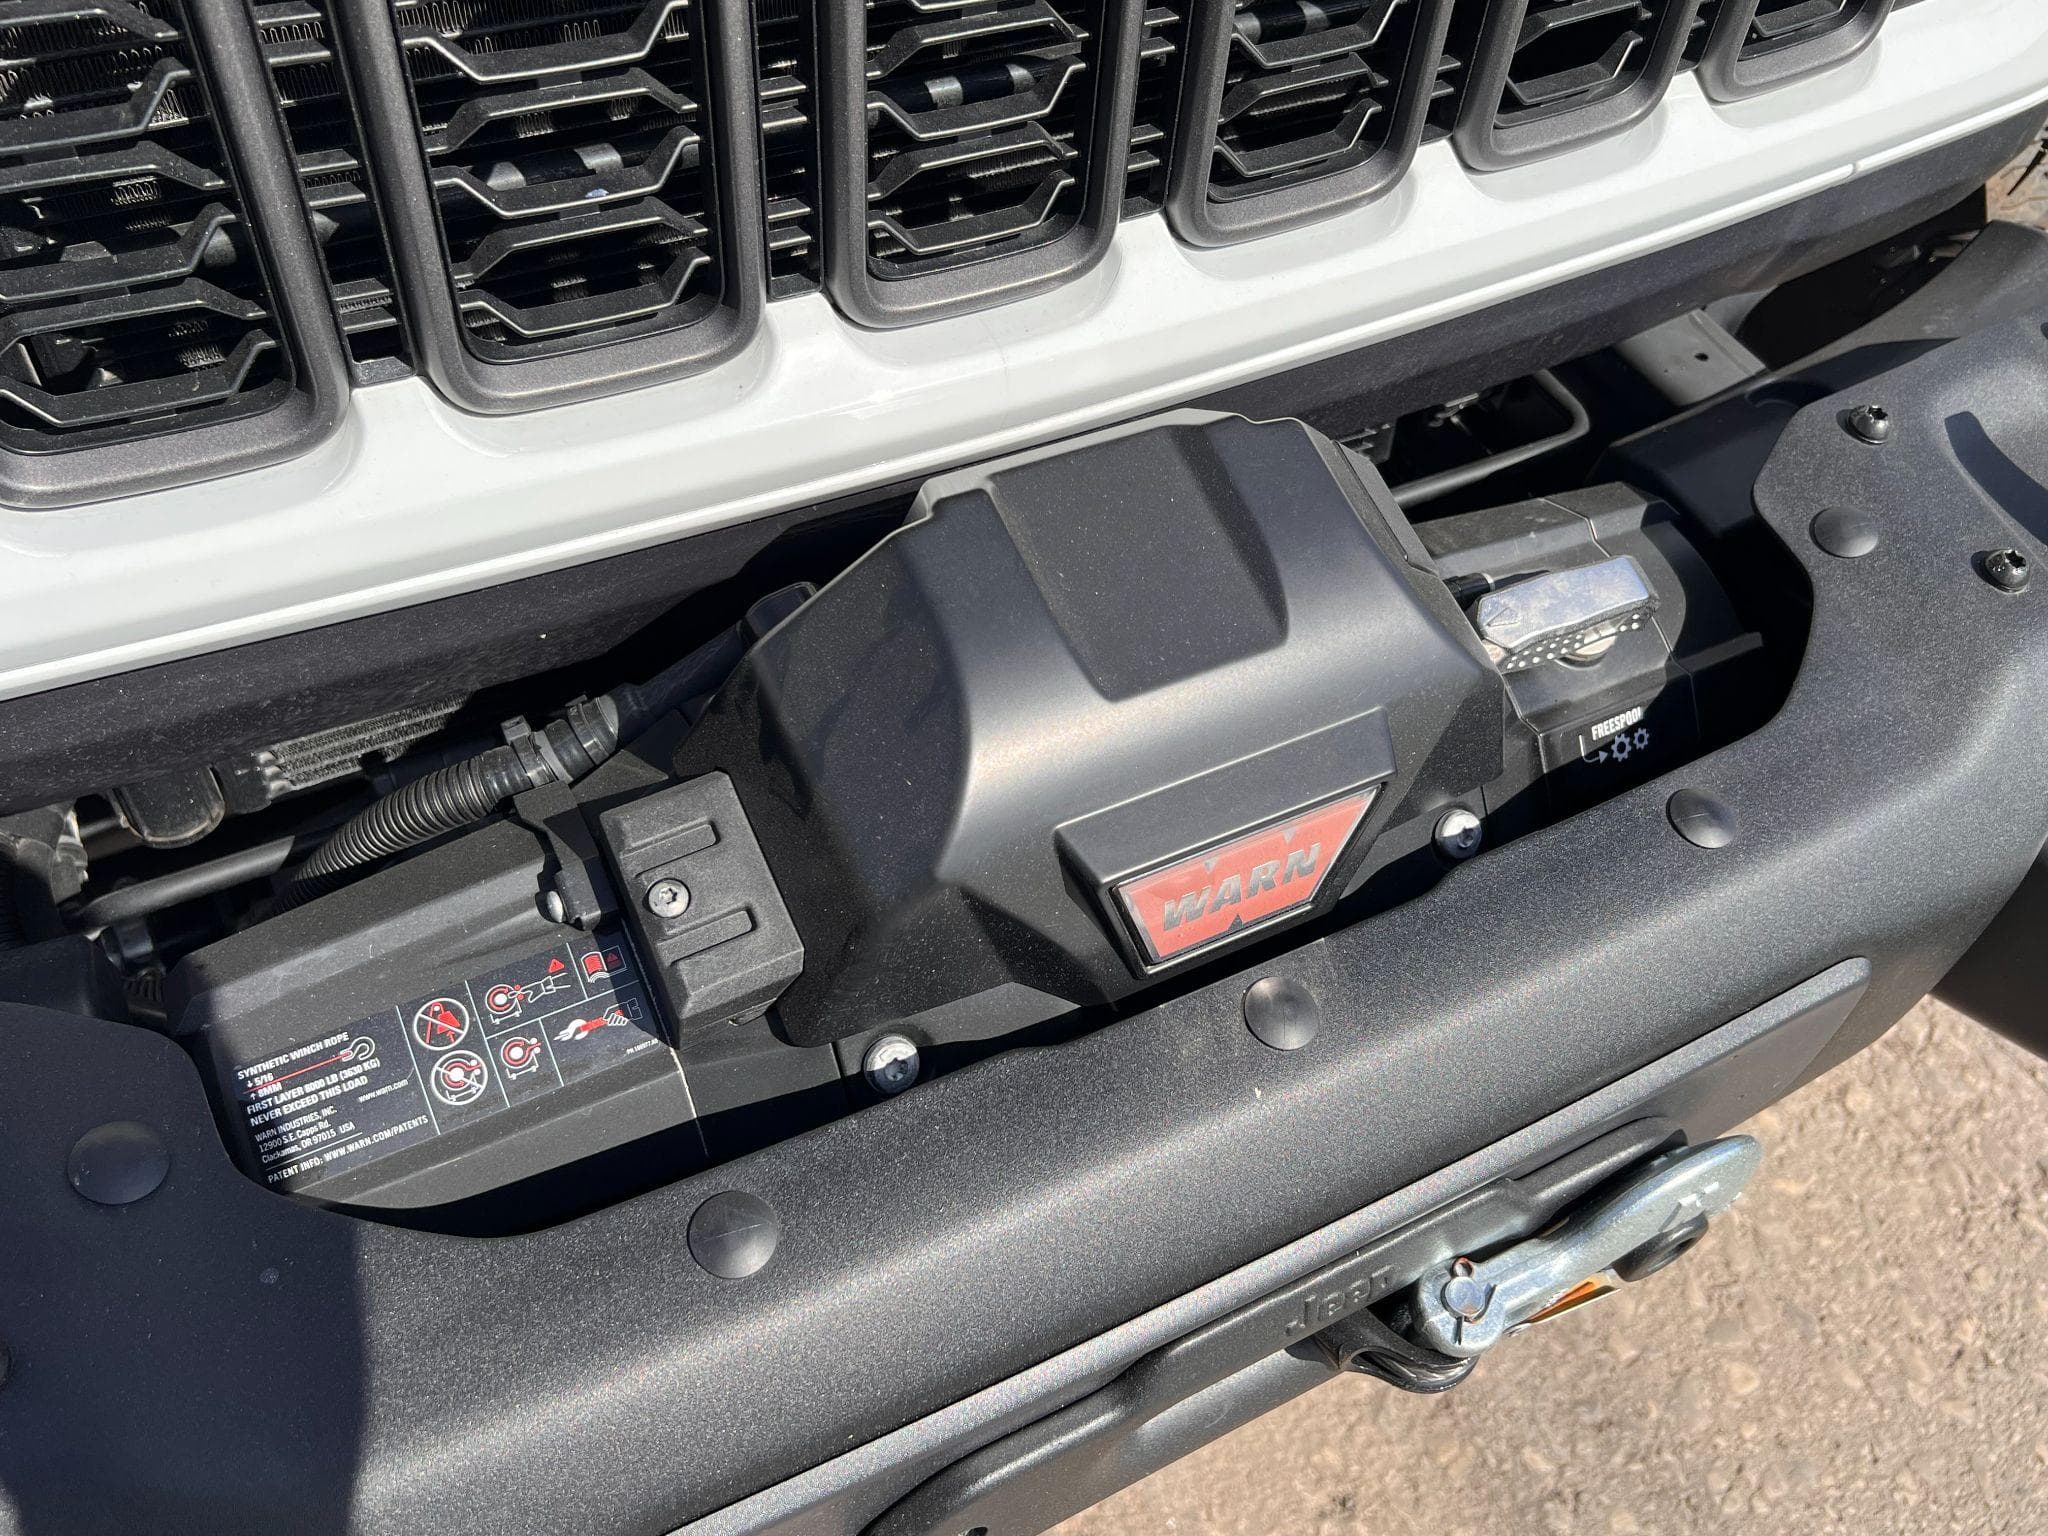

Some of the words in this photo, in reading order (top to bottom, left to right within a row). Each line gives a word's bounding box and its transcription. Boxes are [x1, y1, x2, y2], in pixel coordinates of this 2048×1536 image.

[1163, 842, 1321, 931] WARN
[237, 1053, 290, 1080] SYNTHETIC
[289, 1042, 324, 1062] WINCH
[324, 1031, 350, 1048] ROPE
[246, 1097, 273, 1115] FIRST
[274, 1086, 305, 1105] LAYER
[304, 1078, 326, 1094] 8000
[326, 1073, 339, 1085] LB
[362, 1057, 381, 1071] KG)
[254, 1072, 274, 1086] 5/16
[257, 1081, 283, 1098] 8MM
[358, 1078, 409, 1104] www.warn.com
[249, 1107, 282, 1127] NEVER
[281, 1093, 319, 1115] EXCEED
[318, 1085, 342, 1101] THIS
[342, 1075, 369, 1092] LOAD
[254, 1125, 278, 1143] WARN
[276, 1111, 322, 1134] INDUSTRIES,
[321, 1105, 338, 1117] INC.
[301, 1137, 313, 1148] OR
[312, 1129, 337, 1144] 97015
[338, 1121, 356, 1135] USA
[258, 1138, 283, 1153] 12900
[267, 1164, 300, 1184] PATENT
[300, 1156, 324, 1172] INFO:
[323, 1114, 429, 1162] WWW.WARN.COM/PATENTS
